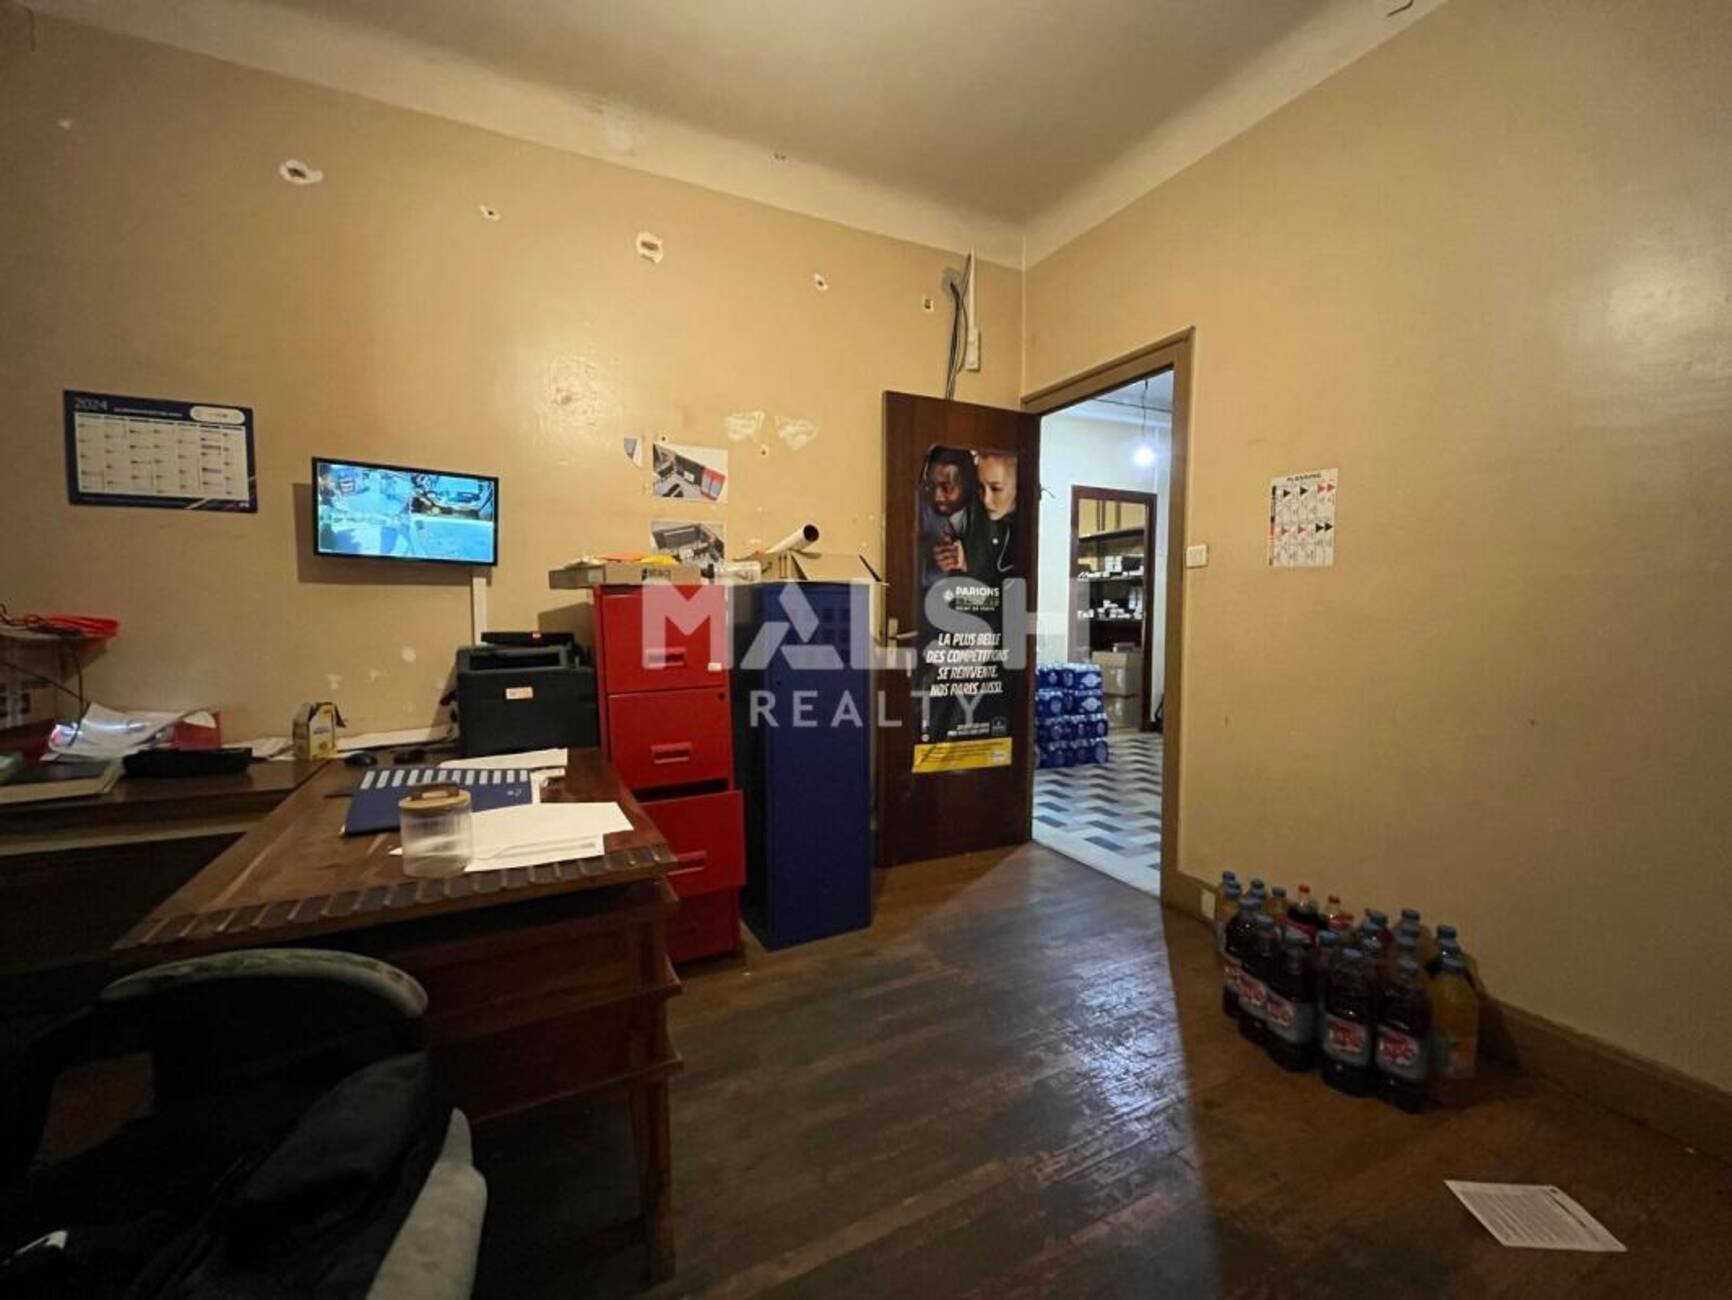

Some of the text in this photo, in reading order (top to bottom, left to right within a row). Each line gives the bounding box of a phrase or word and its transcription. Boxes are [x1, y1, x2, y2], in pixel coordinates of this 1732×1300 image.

[954, 586, 1000, 597] PARIONS
[938, 633, 951, 646] LA
[952, 633, 977, 647] PLUS
[926, 650, 946, 663] DES
[937, 667, 951, 680] SE
[929, 684, 950, 697] NOS
